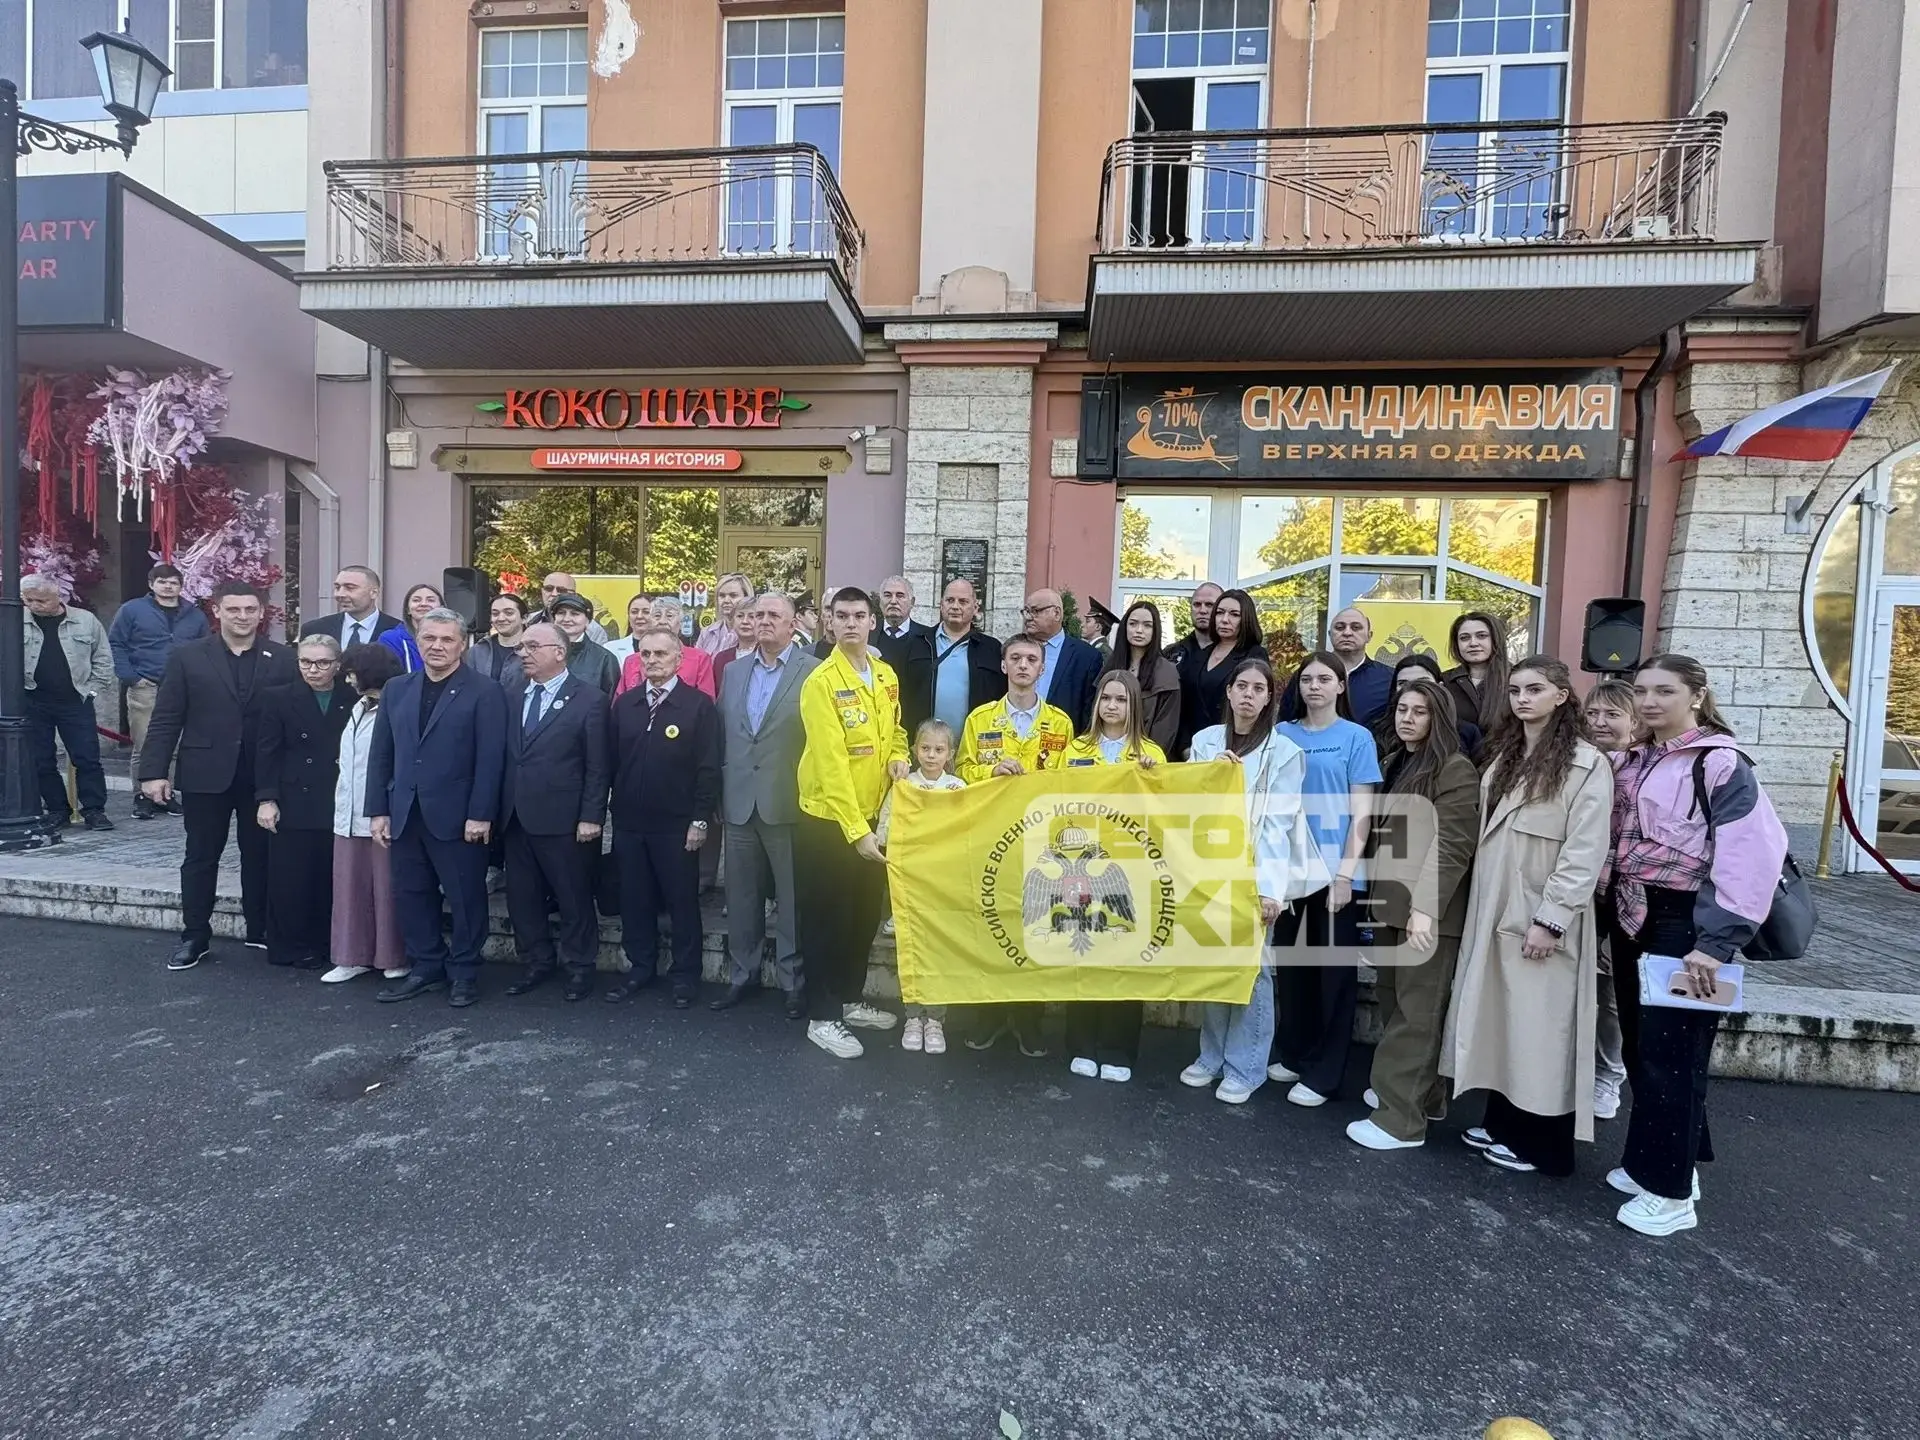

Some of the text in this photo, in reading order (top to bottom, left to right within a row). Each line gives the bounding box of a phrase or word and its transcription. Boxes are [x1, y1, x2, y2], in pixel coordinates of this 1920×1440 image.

[19, 219, 96, 242] ARTY
[19, 258, 57, 280] AR
[502, 386, 784, 431] КОКО ШАВЕ
[1241, 384, 1617, 438] СКАНДИНАВИЯ
[546, 452, 725, 466] ШАУРМИЧНАЯ ИСТОРИЯ
[1262, 444, 1586, 462] ВЕРХНЯЯ ОДЕЖДА
[980, 864, 1028, 968] РОССИЙСКОЕ
